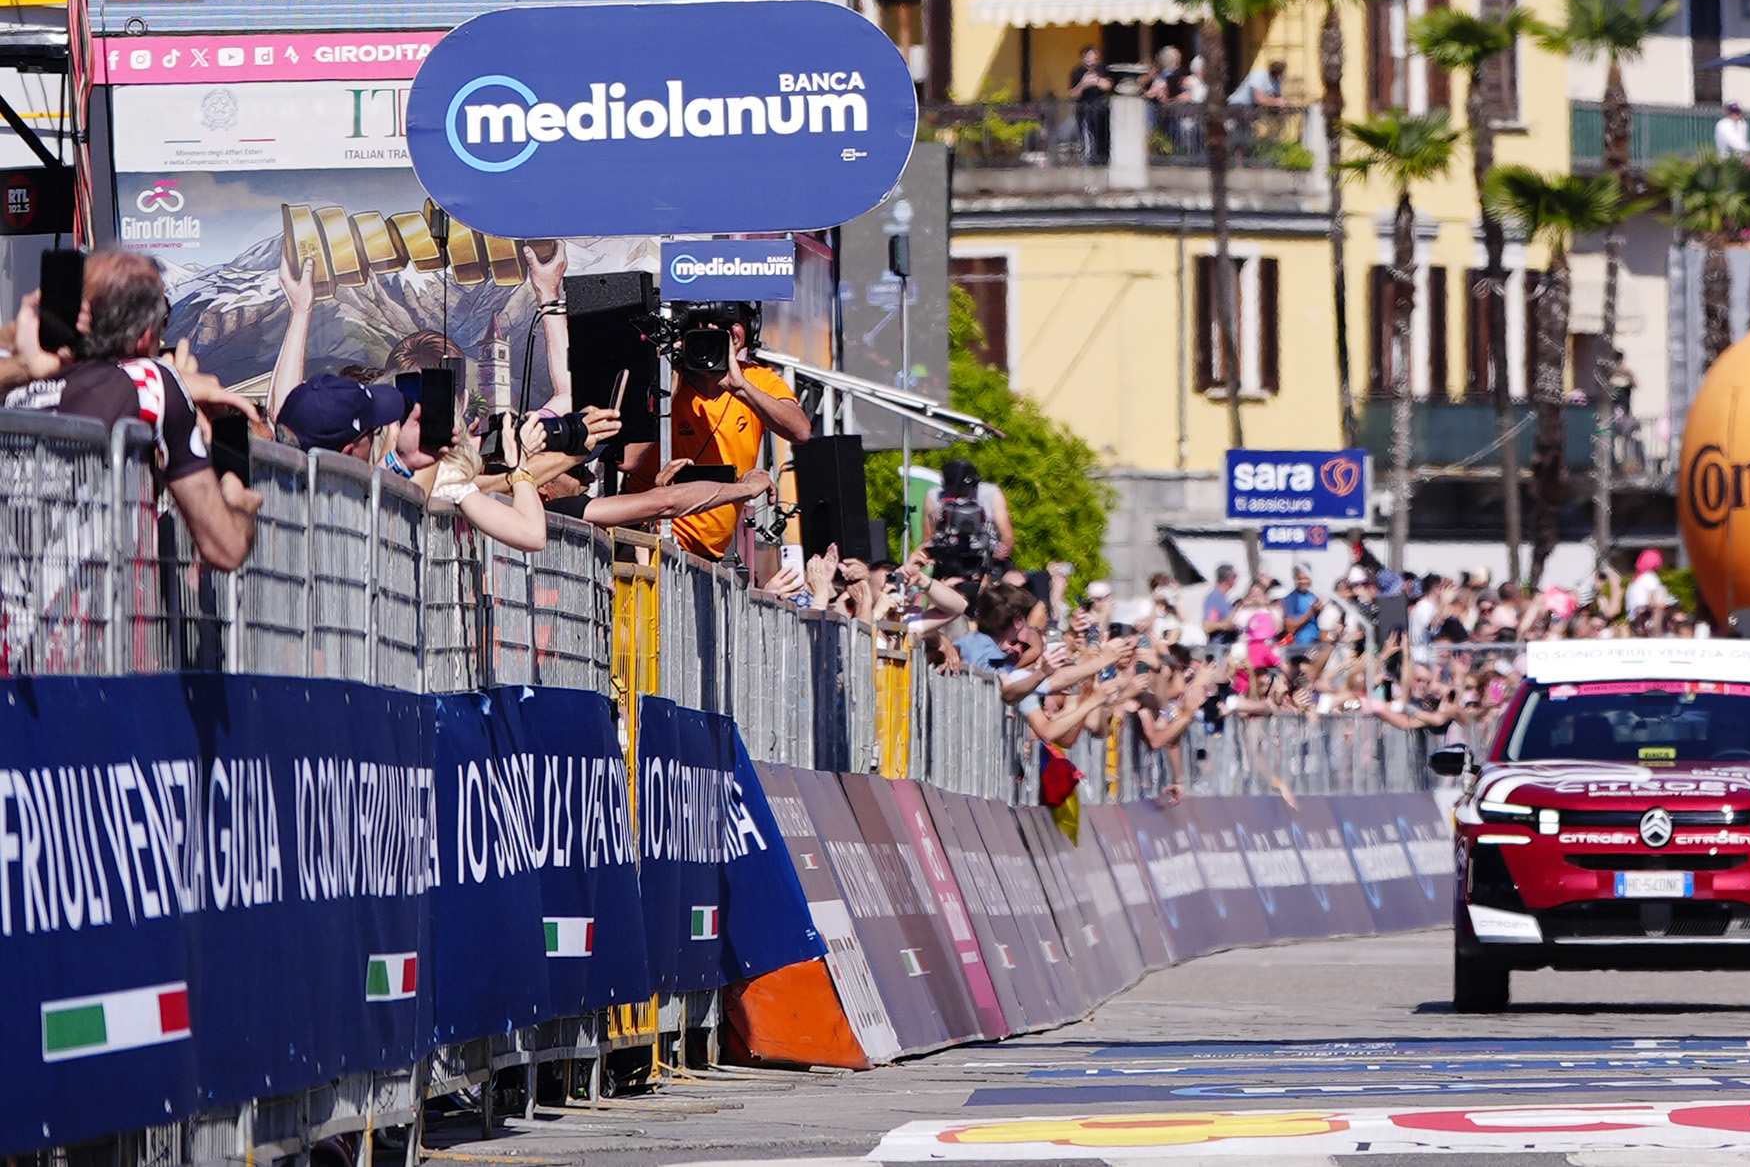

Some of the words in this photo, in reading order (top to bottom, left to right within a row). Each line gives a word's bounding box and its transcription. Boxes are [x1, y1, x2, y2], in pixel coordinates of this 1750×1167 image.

[779, 71, 866, 92] BANCA
[465, 80, 868, 145] mediolanum
[345, 149, 385, 159] ITALIAN
[8, 188, 30, 203] RTL
[8, 204, 30, 214] 102.5
[121, 217, 151, 239] Giro
[153, 215, 200, 238] d'Italia
[676, 257, 794, 276] mediolanum
[1233, 462, 1315, 492] sara
[1233, 494, 1247, 512] ti
[1248, 495, 1313, 512] assicura
[1266, 526, 1305, 543] sara
[1554, 649, 1602, 659] SONO
[1658, 647, 1723, 658] VENEZIA
[644, 756, 664, 860] IO
[457, 760, 488, 884] IO
[208, 754, 283, 912] GIULIA
